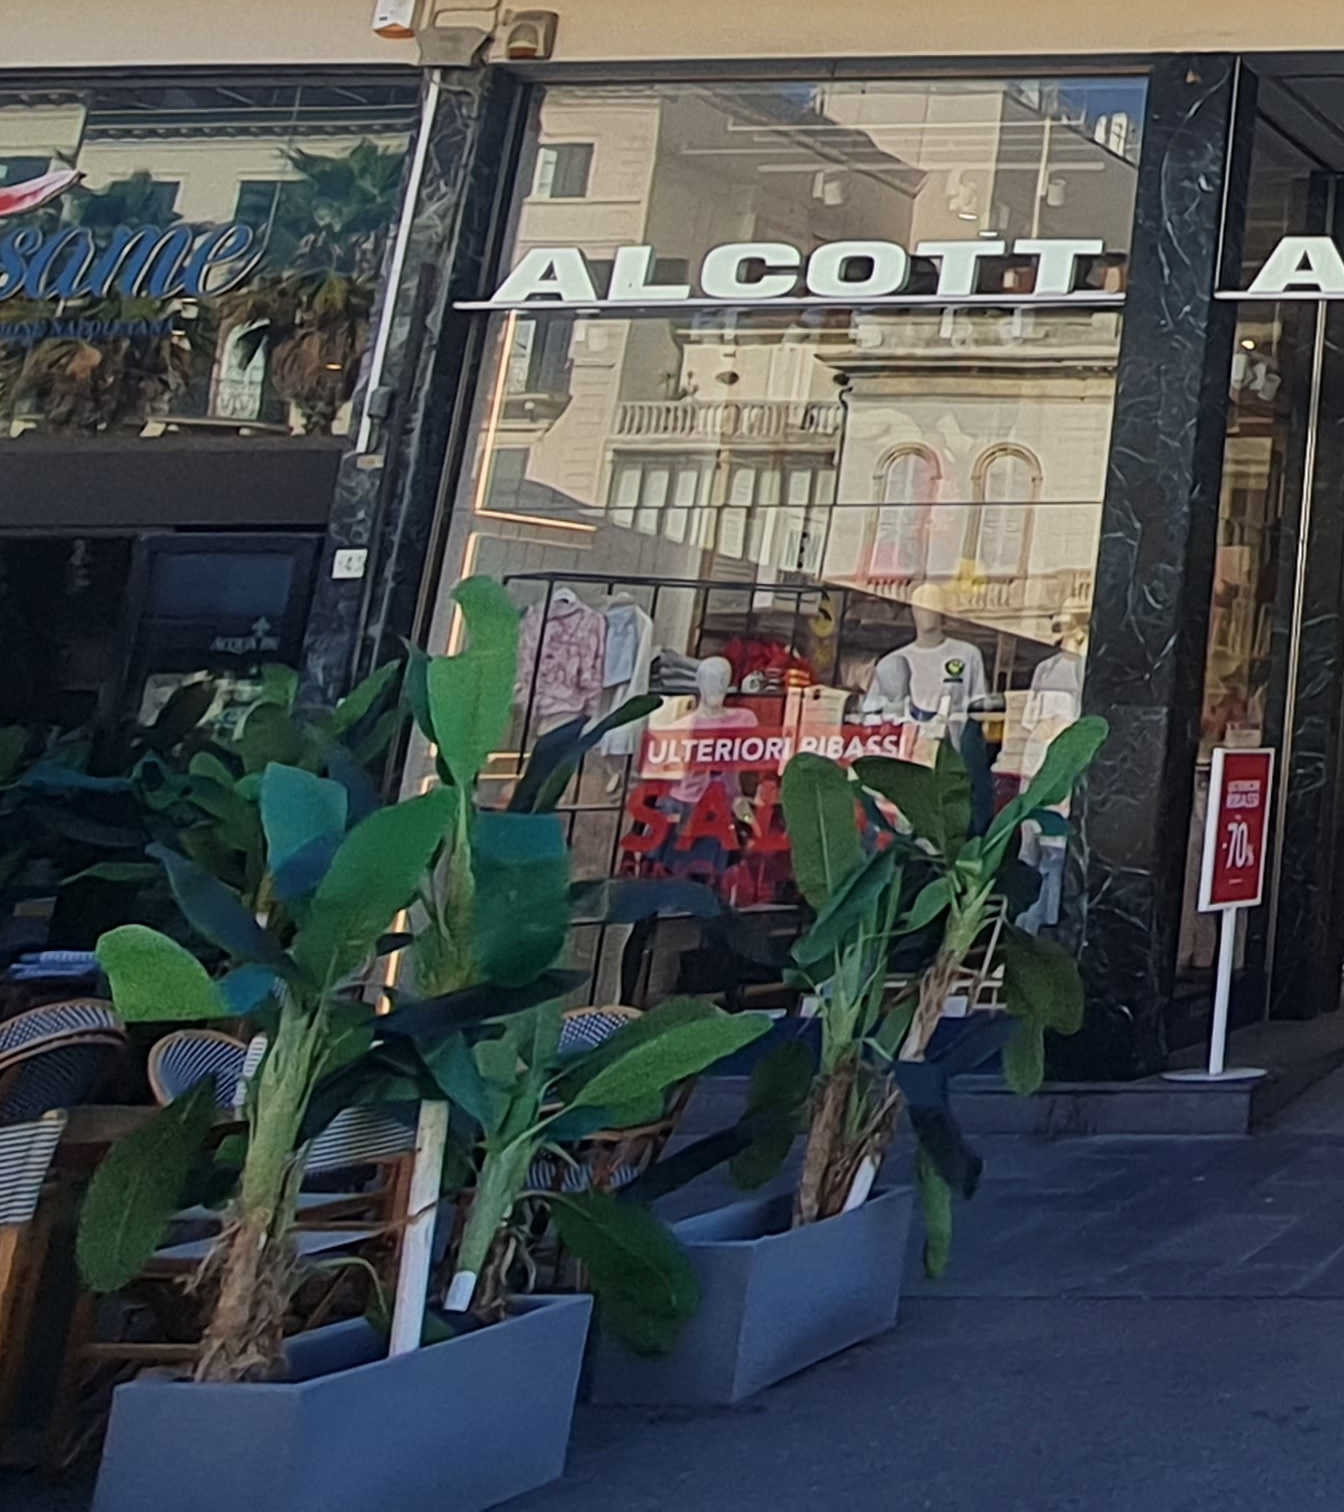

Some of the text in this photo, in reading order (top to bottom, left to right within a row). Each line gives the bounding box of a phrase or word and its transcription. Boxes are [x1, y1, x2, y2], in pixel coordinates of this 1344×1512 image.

[490, 239, 1104, 302] ALCOTT
[648, 733, 905, 764] ULTERIORI RIBASSI
